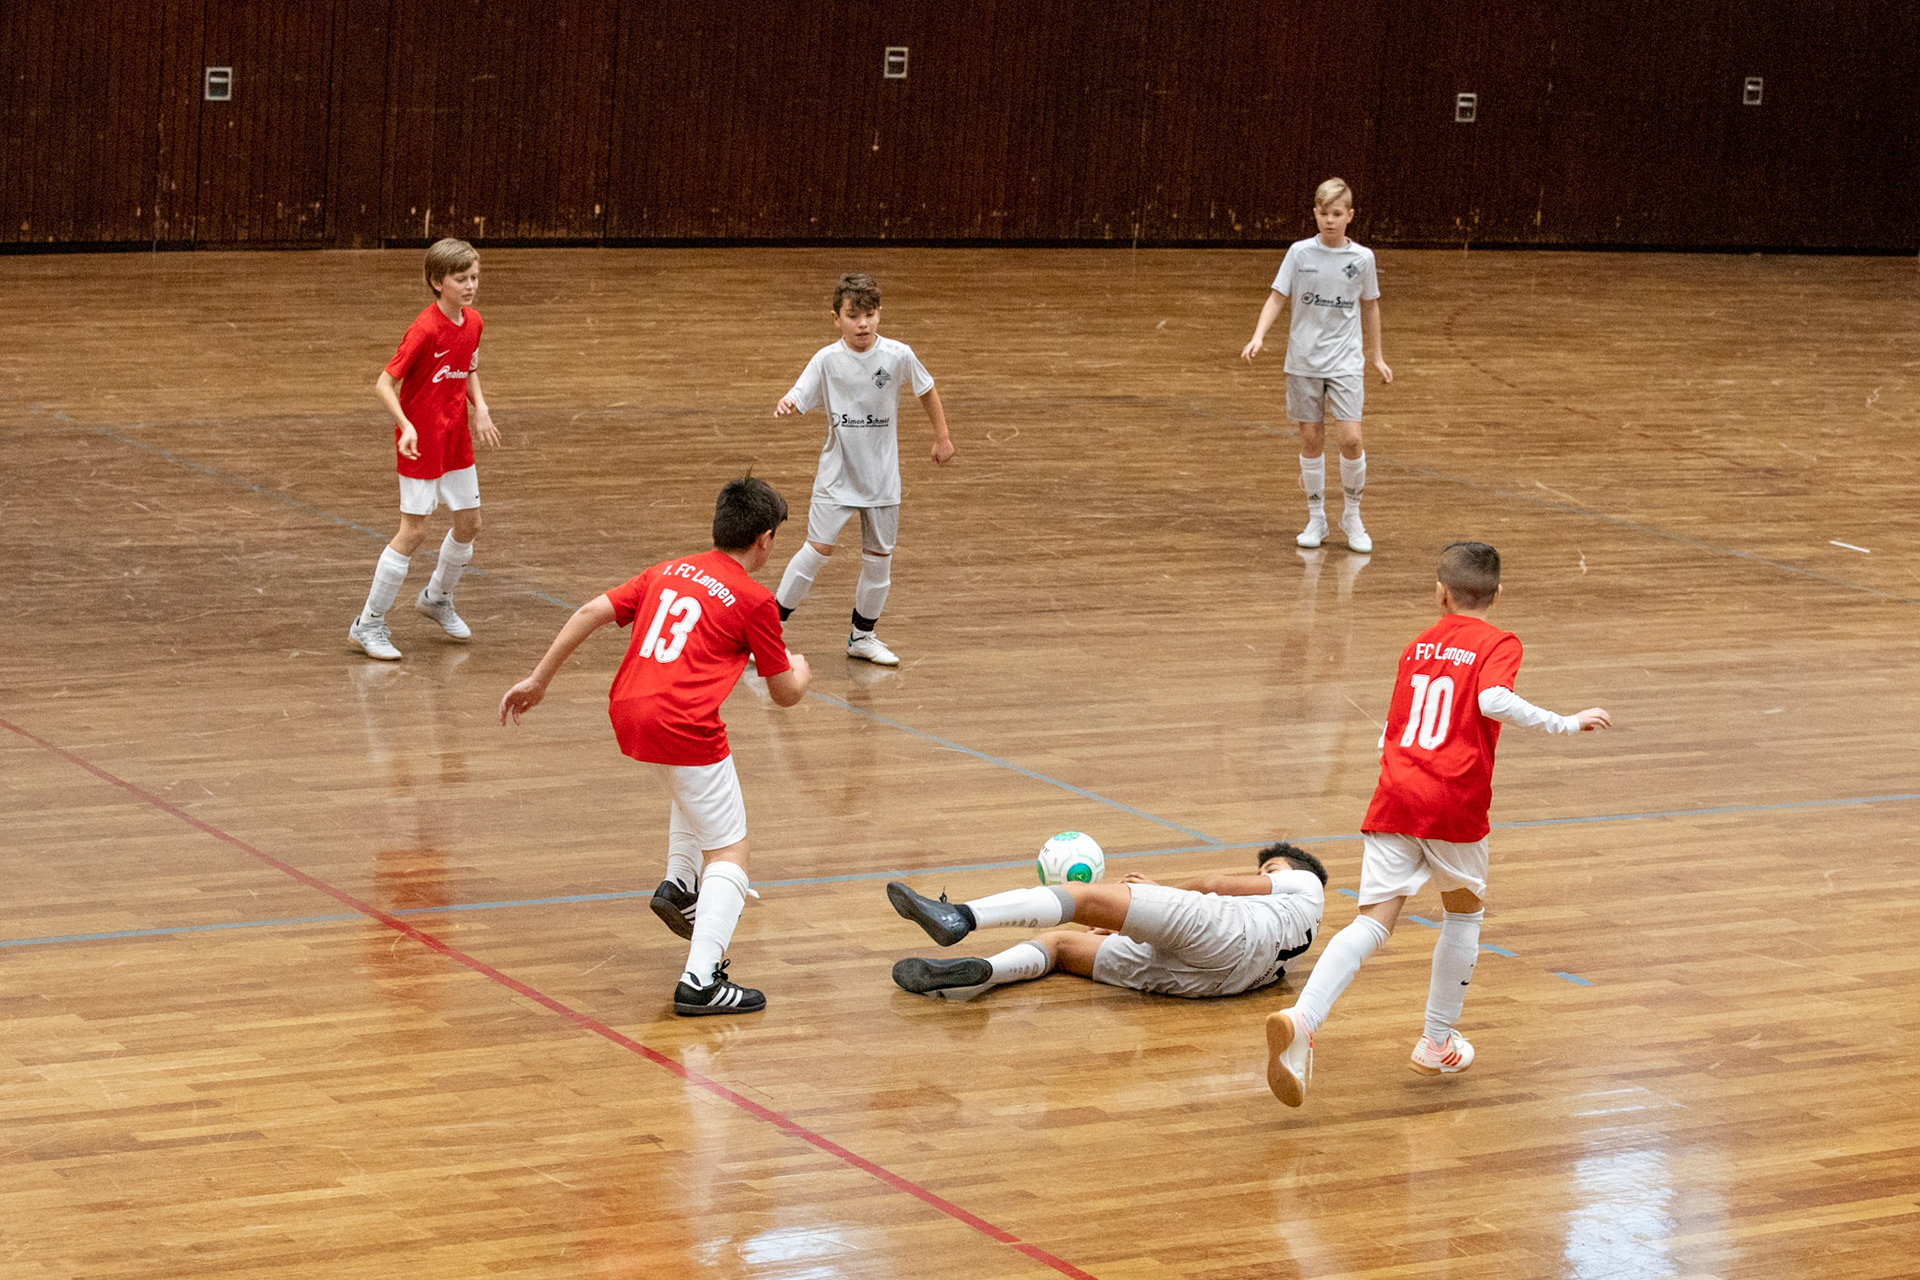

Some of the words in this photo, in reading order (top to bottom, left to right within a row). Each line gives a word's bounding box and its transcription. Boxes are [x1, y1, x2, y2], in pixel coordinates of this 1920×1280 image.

[842, 414, 864, 425] Simon
[662, 561, 674, 576] 1.
[674, 562, 697, 579] FC
[690, 569, 737, 608] Langen
[637, 588, 702, 664] 13
[1415, 642, 1436, 661] FC
[1434, 642, 1477, 666] Langen
[1399, 674, 1455, 751] 10
